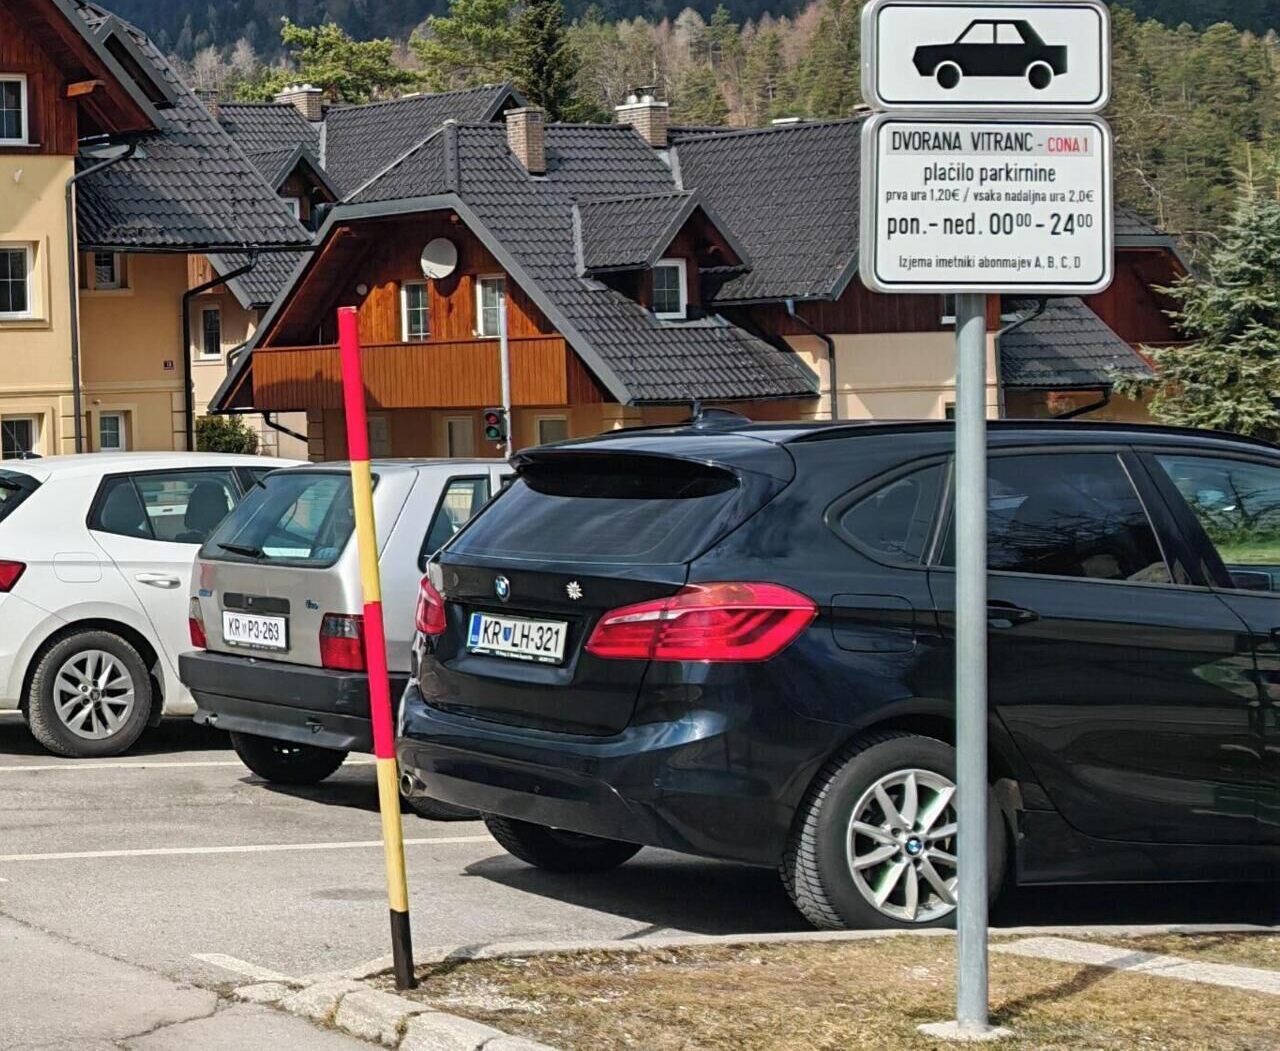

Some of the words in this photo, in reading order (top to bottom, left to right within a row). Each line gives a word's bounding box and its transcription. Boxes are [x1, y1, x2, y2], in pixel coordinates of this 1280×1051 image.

[892, 131, 962, 151] DVORANA
[971, 132, 1033, 152] VITRANC
[1048, 137, 1080, 152] CONA
[1083, 137, 1089, 153] 1
[924, 162, 974, 186] plačilo
[980, 162, 1056, 186] parkirnine
[886, 191, 908, 203] prva
[911, 191, 927, 201] ura
[973, 190, 1002, 202] vsaka
[1005, 190, 1047, 205] nadaljna
[1050, 192, 1066, 202] ura
[943, 212, 983, 235] ned.
[899, 255, 932, 270] Izjema
[935, 255, 975, 268] imetniki
[978, 256, 1032, 271] abonmajev
[1074, 256, 1081, 268] D
[228, 617, 241, 636] KR
[247, 620, 280, 642] P3-263
[482, 619, 502, 645] KR
[511, 623, 561, 653] LH-321
